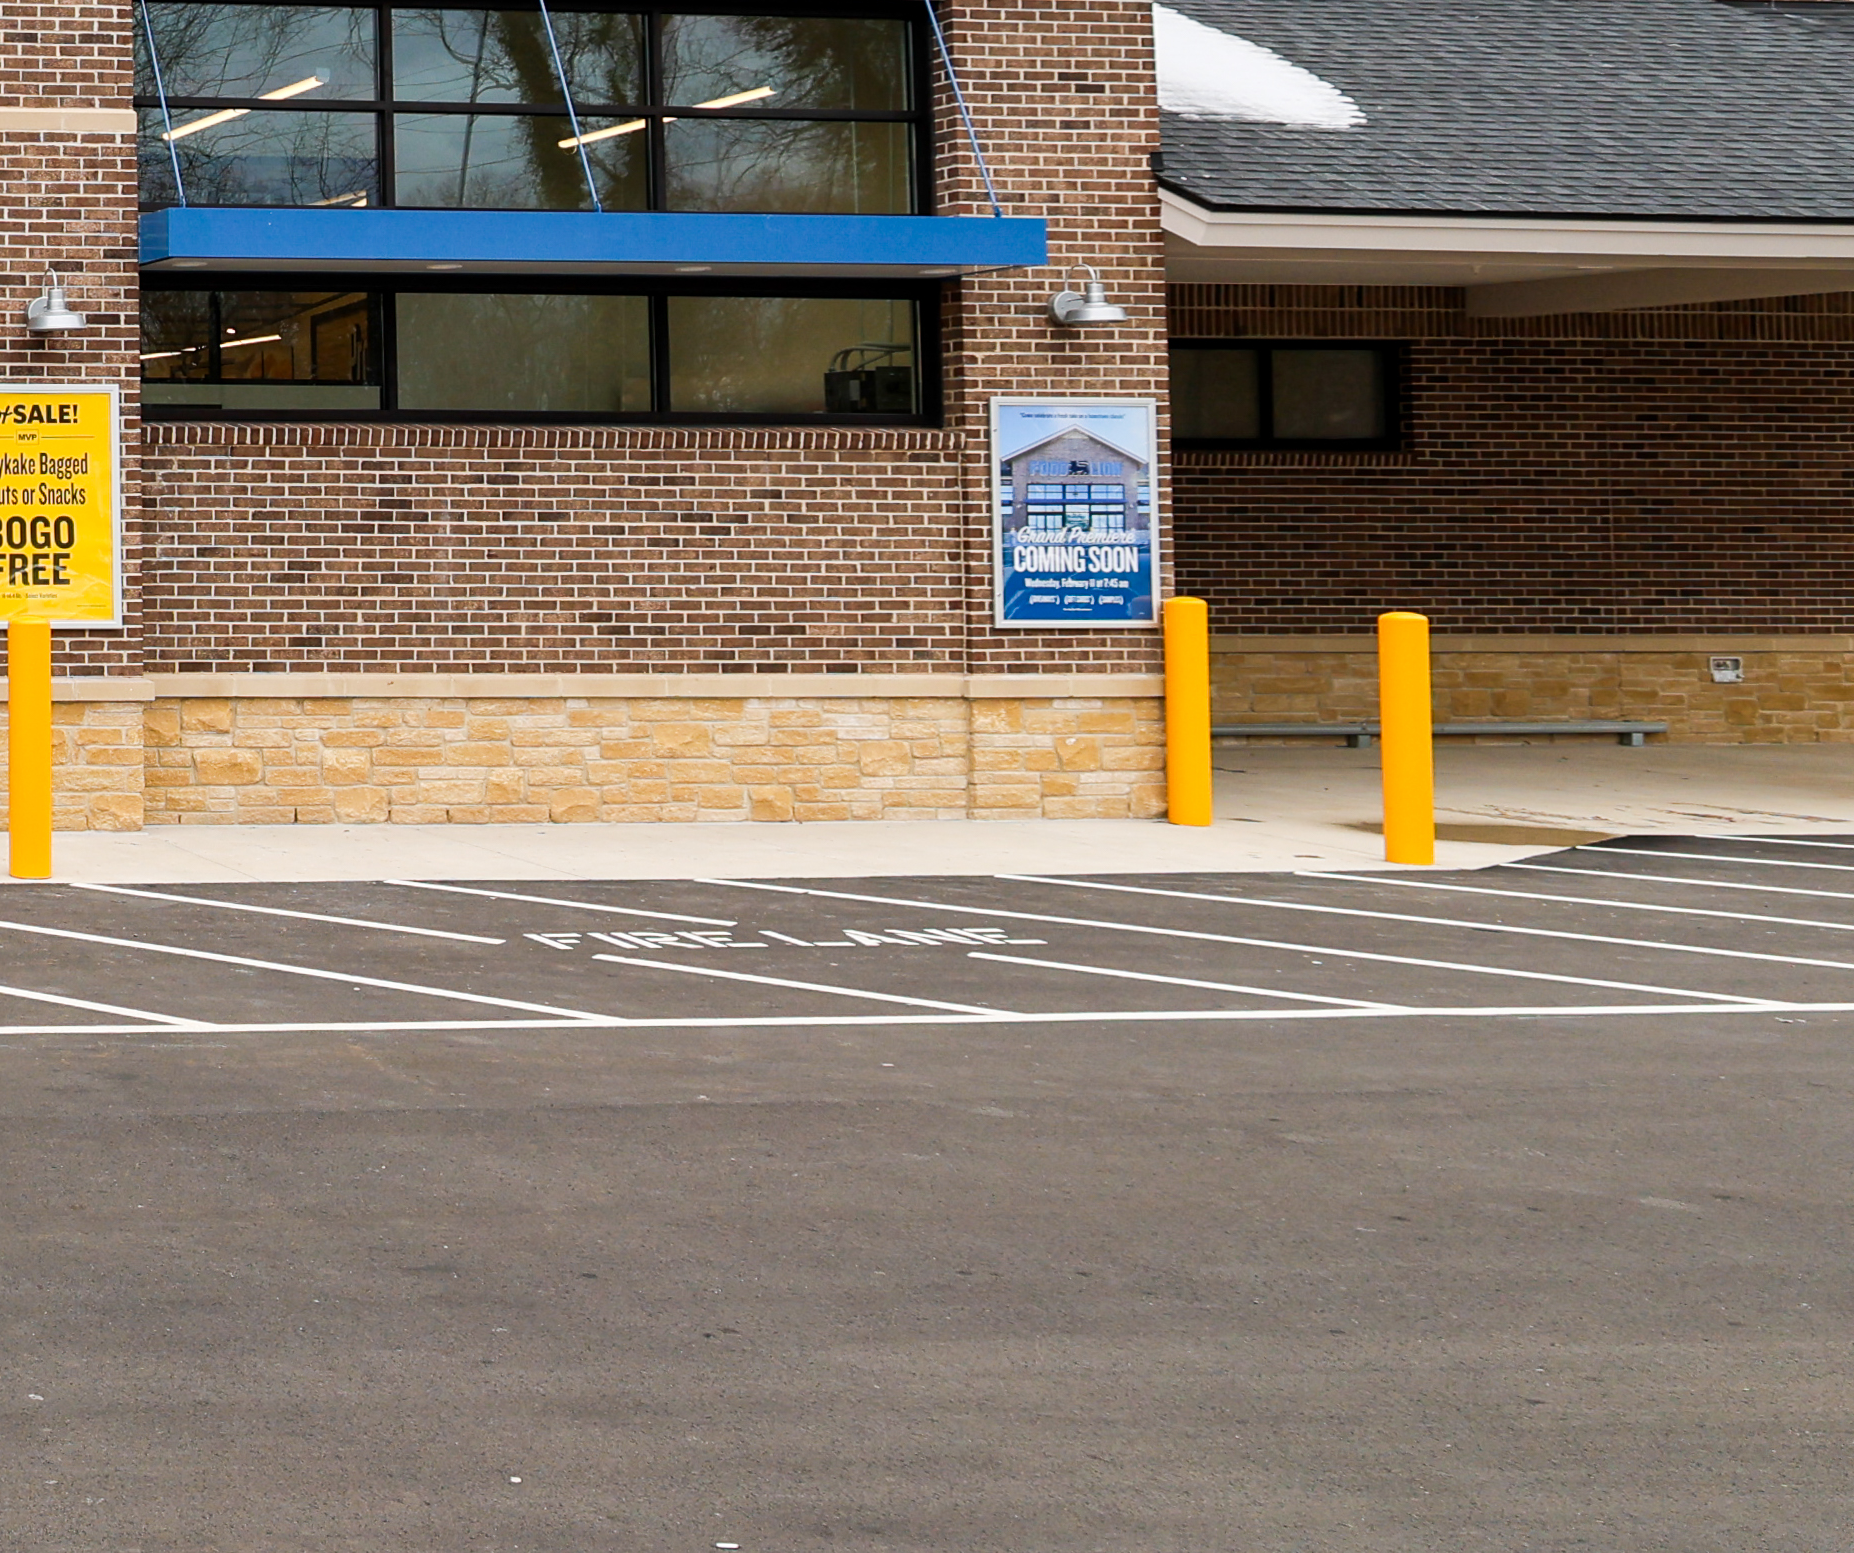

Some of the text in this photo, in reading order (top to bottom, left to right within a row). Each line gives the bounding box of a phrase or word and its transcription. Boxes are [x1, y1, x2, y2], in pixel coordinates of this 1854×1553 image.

[13, 404, 78, 424] SALE!
[40, 452, 88, 480] Bagged
[1028, 460, 1123, 476] FOOD LION
[22, 488, 35, 505] or
[39, 482, 86, 505] Snacks
[1017, 526, 1136, 543] Grand Premiere
[1013, 546, 1139, 573] COMING SOON
[523, 928, 1049, 950] FIRE LANE
